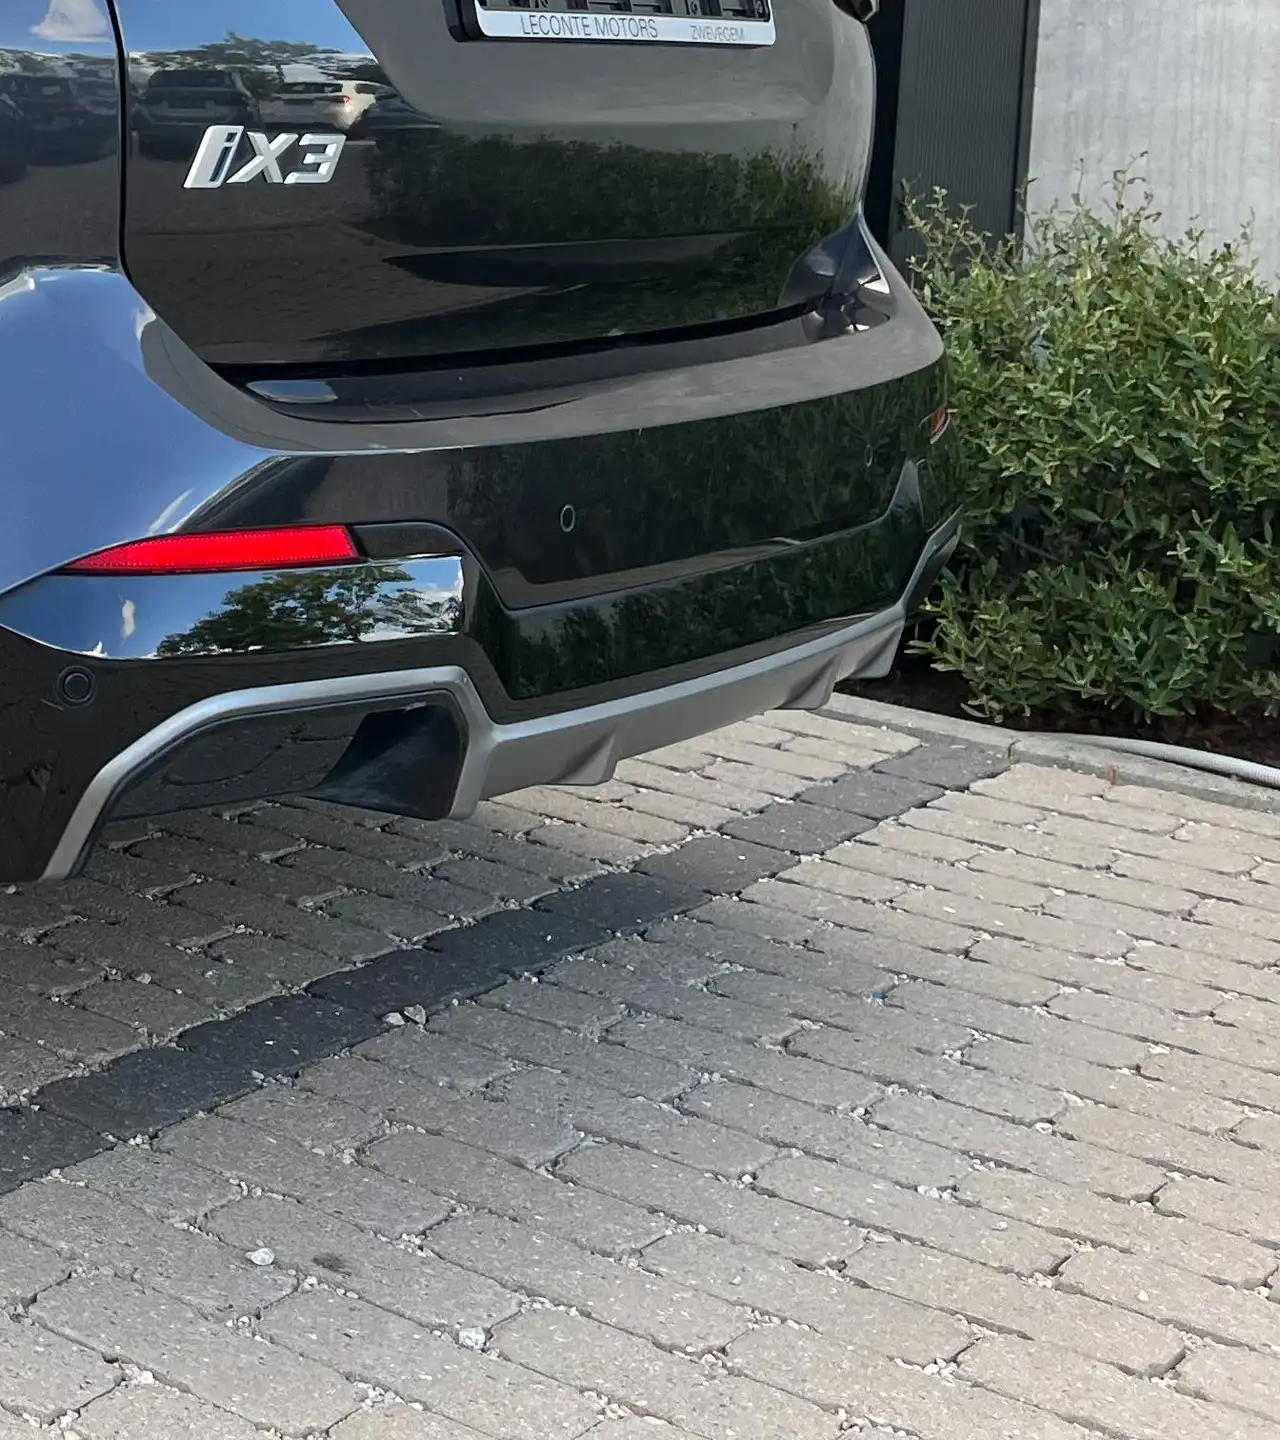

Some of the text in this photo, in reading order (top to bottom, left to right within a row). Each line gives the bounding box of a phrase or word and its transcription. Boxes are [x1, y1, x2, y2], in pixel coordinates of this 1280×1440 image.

[520, 14, 658, 39] LECONTE MOTORS
[690, 25, 745, 41] ZWEVEGEM
